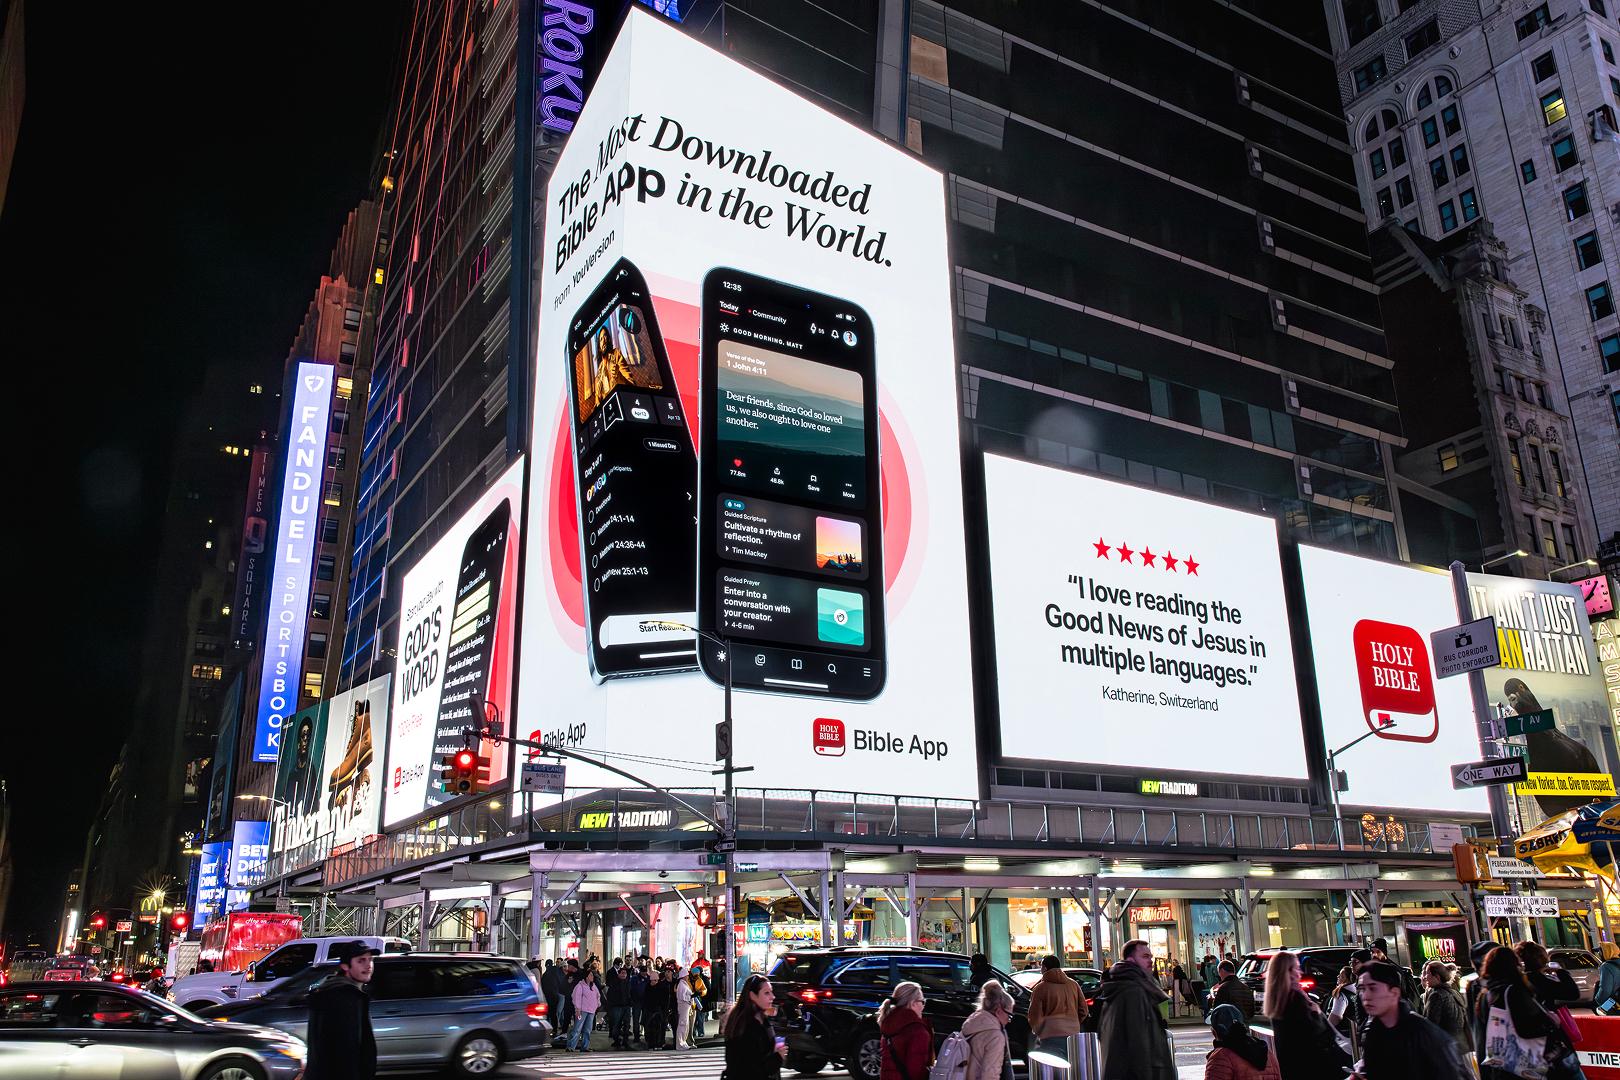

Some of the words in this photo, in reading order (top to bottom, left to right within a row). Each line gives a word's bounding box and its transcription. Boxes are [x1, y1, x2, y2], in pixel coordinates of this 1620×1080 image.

[558, 166, 592, 227] The
[594, 113, 647, 184] Most
[649, 116, 873, 215] Downloaded
[555, 202, 598, 275] Bible
[602, 161, 666, 217] App
[676, 173, 713, 213] in
[719, 186, 773, 229] the
[785, 201, 893, 267] World.
[554, 284, 571, 311] from
[572, 230, 615, 287] YouVersion
[722, 281, 742, 292] 12:35
[719, 300, 739, 312] Today
[752, 309, 787, 325] Community
[733, 327, 752, 337] GOOD
[753, 332, 785, 346] MORNING,
[786, 340, 803, 350] MATT
[726, 351, 741, 360] Verse
[756, 359, 766, 367] Day
[726, 360, 731, 368] 1
[733, 362, 751, 373] John
[752, 366, 767, 376] 4:11
[726, 390, 746, 402] Dear
[746, 394, 776, 411] friends,
[777, 402, 797, 414] since
[797, 406, 813, 419] God
[813, 411, 823, 421] so
[823, 411, 843, 425] loved
[726, 404, 738, 415] us,
[739, 407, 751, 416] we
[751, 408, 767, 419] also
[768, 413, 791, 426] ought
[791, 416, 800, 426] to
[800, 418, 816, 430] love
[816, 422, 831, 434] one
[726, 416, 759, 430] another.
[256, 452, 269, 513] TIMES
[286, 405, 321, 563] FANDUEL
[807, 484, 820, 492] Save
[842, 490, 856, 499] More
[724, 510, 743, 520] Guided
[742, 513, 767, 524] Scripture
[724, 520, 758, 534] Cultivate
[759, 527, 765, 535] a
[765, 527, 791, 541] rhythm
[792, 532, 801, 541] of
[724, 531, 763, 545] reflection.
[732, 546, 744, 556] Tim
[744, 548, 768, 560] Mackey
[621, 566, 649, 576] 25:1-13
[723, 575, 743, 585] Guided
[743, 578, 760, 588] Prayer
[240, 557, 256, 636] SQUARE
[724, 586, 745, 597] Enter
[746, 588, 761, 598] into
[762, 592, 768, 600] a
[1089, 578, 1132, 607] love
[1136, 591, 1209, 625] reading
[1211, 600, 1242, 625] the
[723, 597, 774, 611] conversation
[774, 603, 791, 614] with
[1470, 585, 1489, 618] IT
[1494, 590, 1540, 631] AIN'T
[1540, 593, 1580, 636] JUST
[723, 609, 742, 621] your
[743, 611, 773, 623] creator.
[639, 623, 658, 633] Start
[731, 620, 743, 630] 4-6
[743, 621, 755, 631] min
[1045, 603, 1103, 634] Good
[1108, 612, 1164, 643] News
[1168, 624, 1188, 647] of
[1191, 626, 1247, 656] Jesus
[1249, 635, 1267, 658] in
[405, 605, 442, 666] GOD'S
[1061, 643, 1146, 676] multiple
[1370, 641, 1414, 667] HOLY
[1443, 652, 1456, 663] BUS
[1457, 644, 1489, 659] CORRIDOR
[1496, 627, 1592, 677] ANHATTAN
[266, 576, 298, 748] SPORTSBOOK
[1441, 662, 1461, 674] PHOTO
[1462, 654, 1495, 670] ENFORCED
[402, 648, 439, 704] WORD
[1372, 666, 1421, 692] BIBLE
[1102, 685, 1158, 707] Katherine,
[1159, 691, 1219, 712] Switzerland
[819, 724, 839, 734] HOLY
[1517, 717, 1525, 732] 7
[1529, 714, 1541, 725] AV
[566, 722, 587, 748] App
[819, 732, 840, 742] BIBLE
[853, 729, 904, 753] Bible
[908, 734, 948, 761] App
[1463, 769, 1483, 782] ONE
[1493, 764, 1516, 777] WAY
[1141, 780, 1198, 796] NEWTRADITION
[1557, 778, 1568, 790] too.
[1568, 776, 1581, 791] Give
[1581, 779, 1590, 790] me
[1590, 778, 1613, 792] respect.
[202, 863, 216, 874] BET
[1486, 897, 1522, 906] PEDESTRIAN
[1523, 897, 1540, 906] FLOW
[1540, 897, 1557, 906] ZONE
[1487, 906, 1502, 914] KEEP
[1588, 1053, 1620, 1067] TIME
